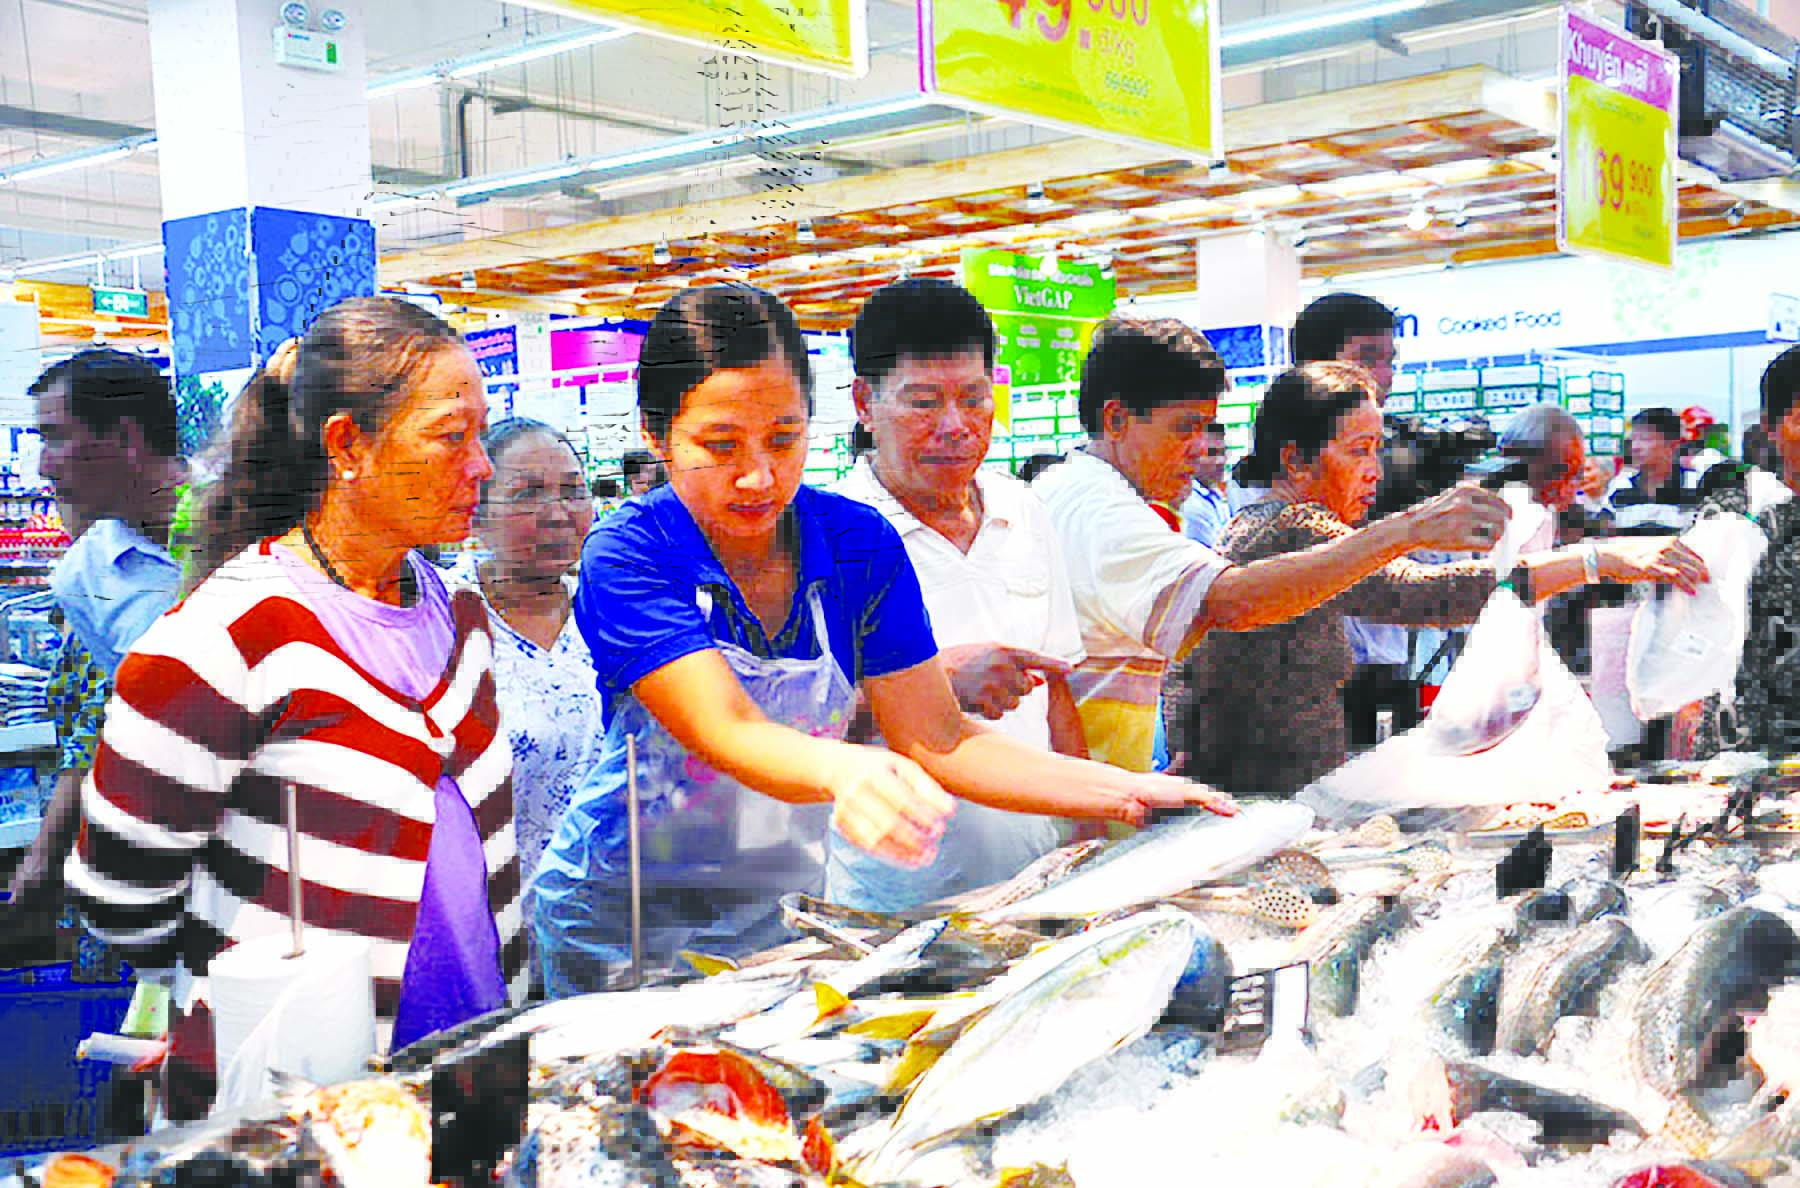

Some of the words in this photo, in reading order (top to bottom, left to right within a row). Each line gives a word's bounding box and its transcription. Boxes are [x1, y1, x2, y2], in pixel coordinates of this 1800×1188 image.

[1013, 284, 1073, 310] VietGAP
[1438, 315, 1507, 334] Cooked
[1514, 310, 1561, 328] Food
